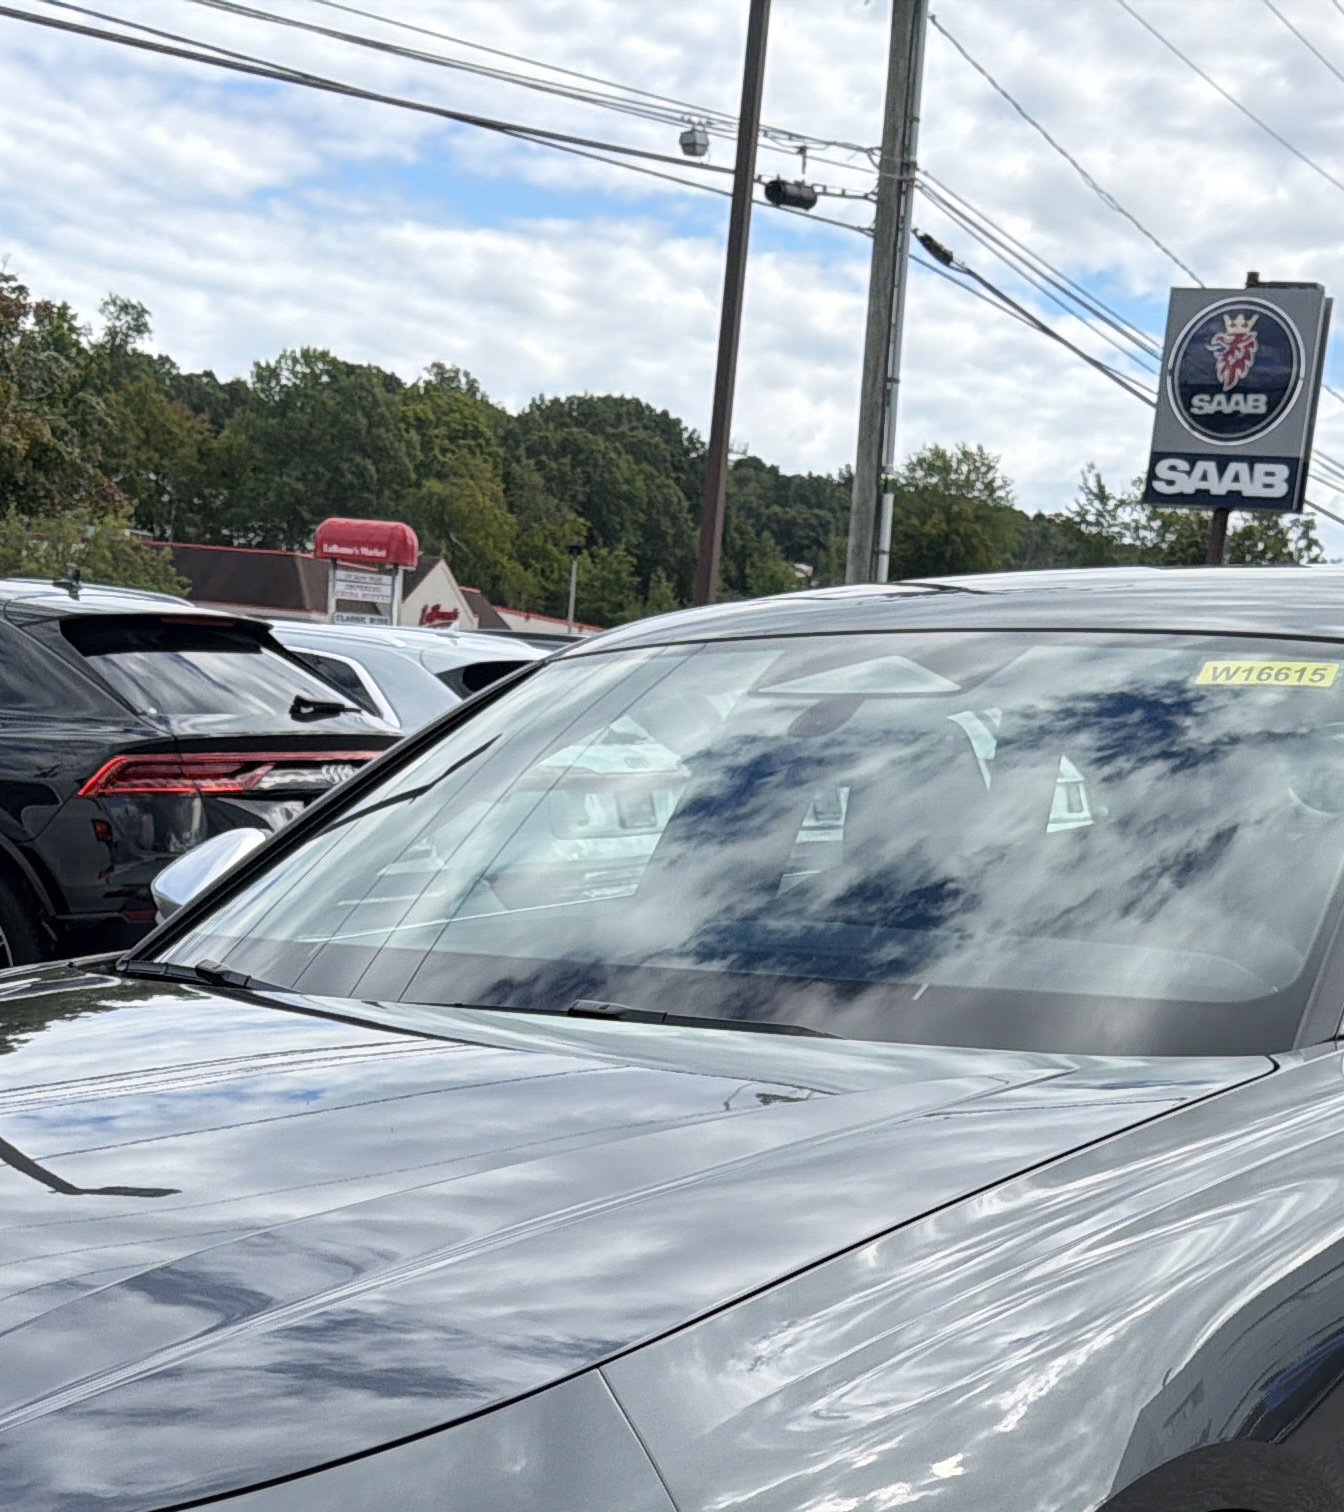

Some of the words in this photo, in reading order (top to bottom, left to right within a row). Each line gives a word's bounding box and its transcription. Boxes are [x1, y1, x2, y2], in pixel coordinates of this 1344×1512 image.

[1189, 393, 1268, 415] SAAB
[1152, 458, 1290, 498] SAAB
[1211, 666, 1328, 683] W16615
